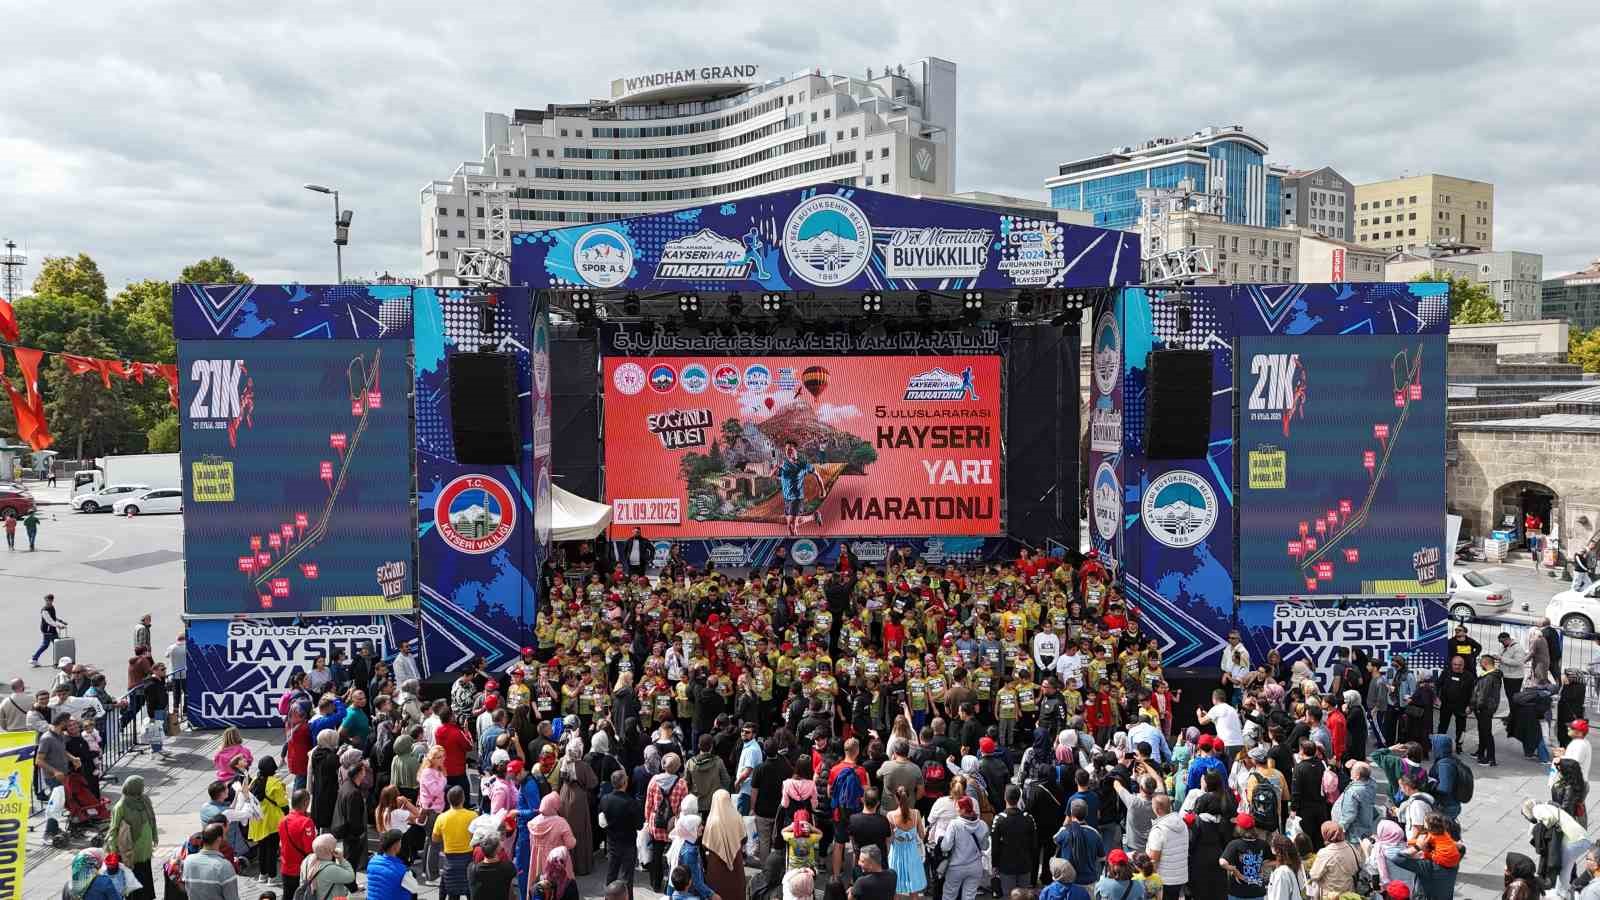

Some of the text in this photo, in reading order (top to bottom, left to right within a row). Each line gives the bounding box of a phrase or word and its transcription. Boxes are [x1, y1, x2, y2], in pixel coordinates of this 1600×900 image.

[626, 65, 758, 91] WYNDHAM GRAND
[582, 264, 606, 273] SPOR
[894, 246, 987, 269] BÜYÜKKILIÇ
[660, 264, 747, 277] MARATONU
[190, 359, 244, 418] 21K
[1248, 354, 1298, 410] 21K
[466, 479, 484, 488] T.C.
[922, 459, 993, 485] YARI
[617, 502, 678, 521] 21.09.2025
[840, 496, 993, 521] MARATONU
